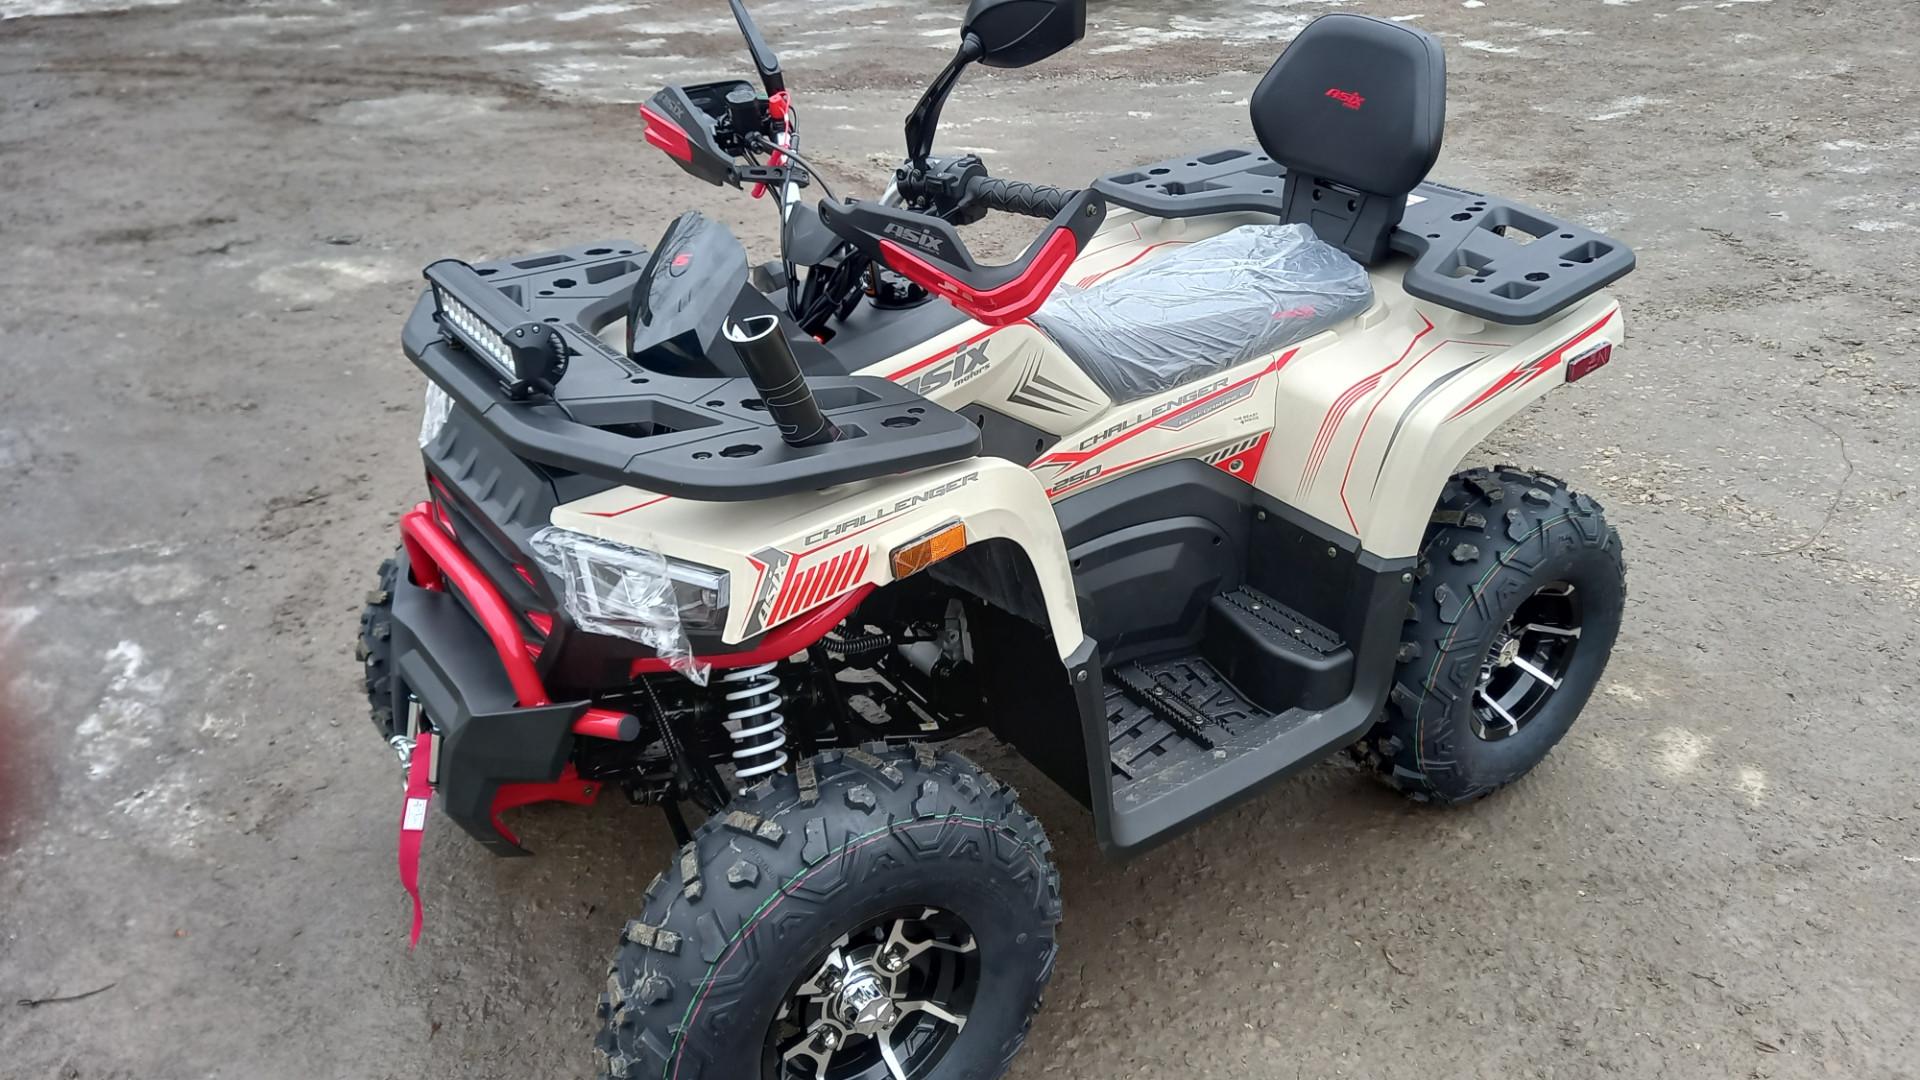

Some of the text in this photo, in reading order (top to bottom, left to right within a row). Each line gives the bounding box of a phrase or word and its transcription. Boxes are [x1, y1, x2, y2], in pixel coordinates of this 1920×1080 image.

[953, 362, 991, 388] motors
[1079, 377, 1229, 451] CHALLENGER
[1052, 464, 1103, 492] 250
[805, 471, 979, 547] CHALLENGER
